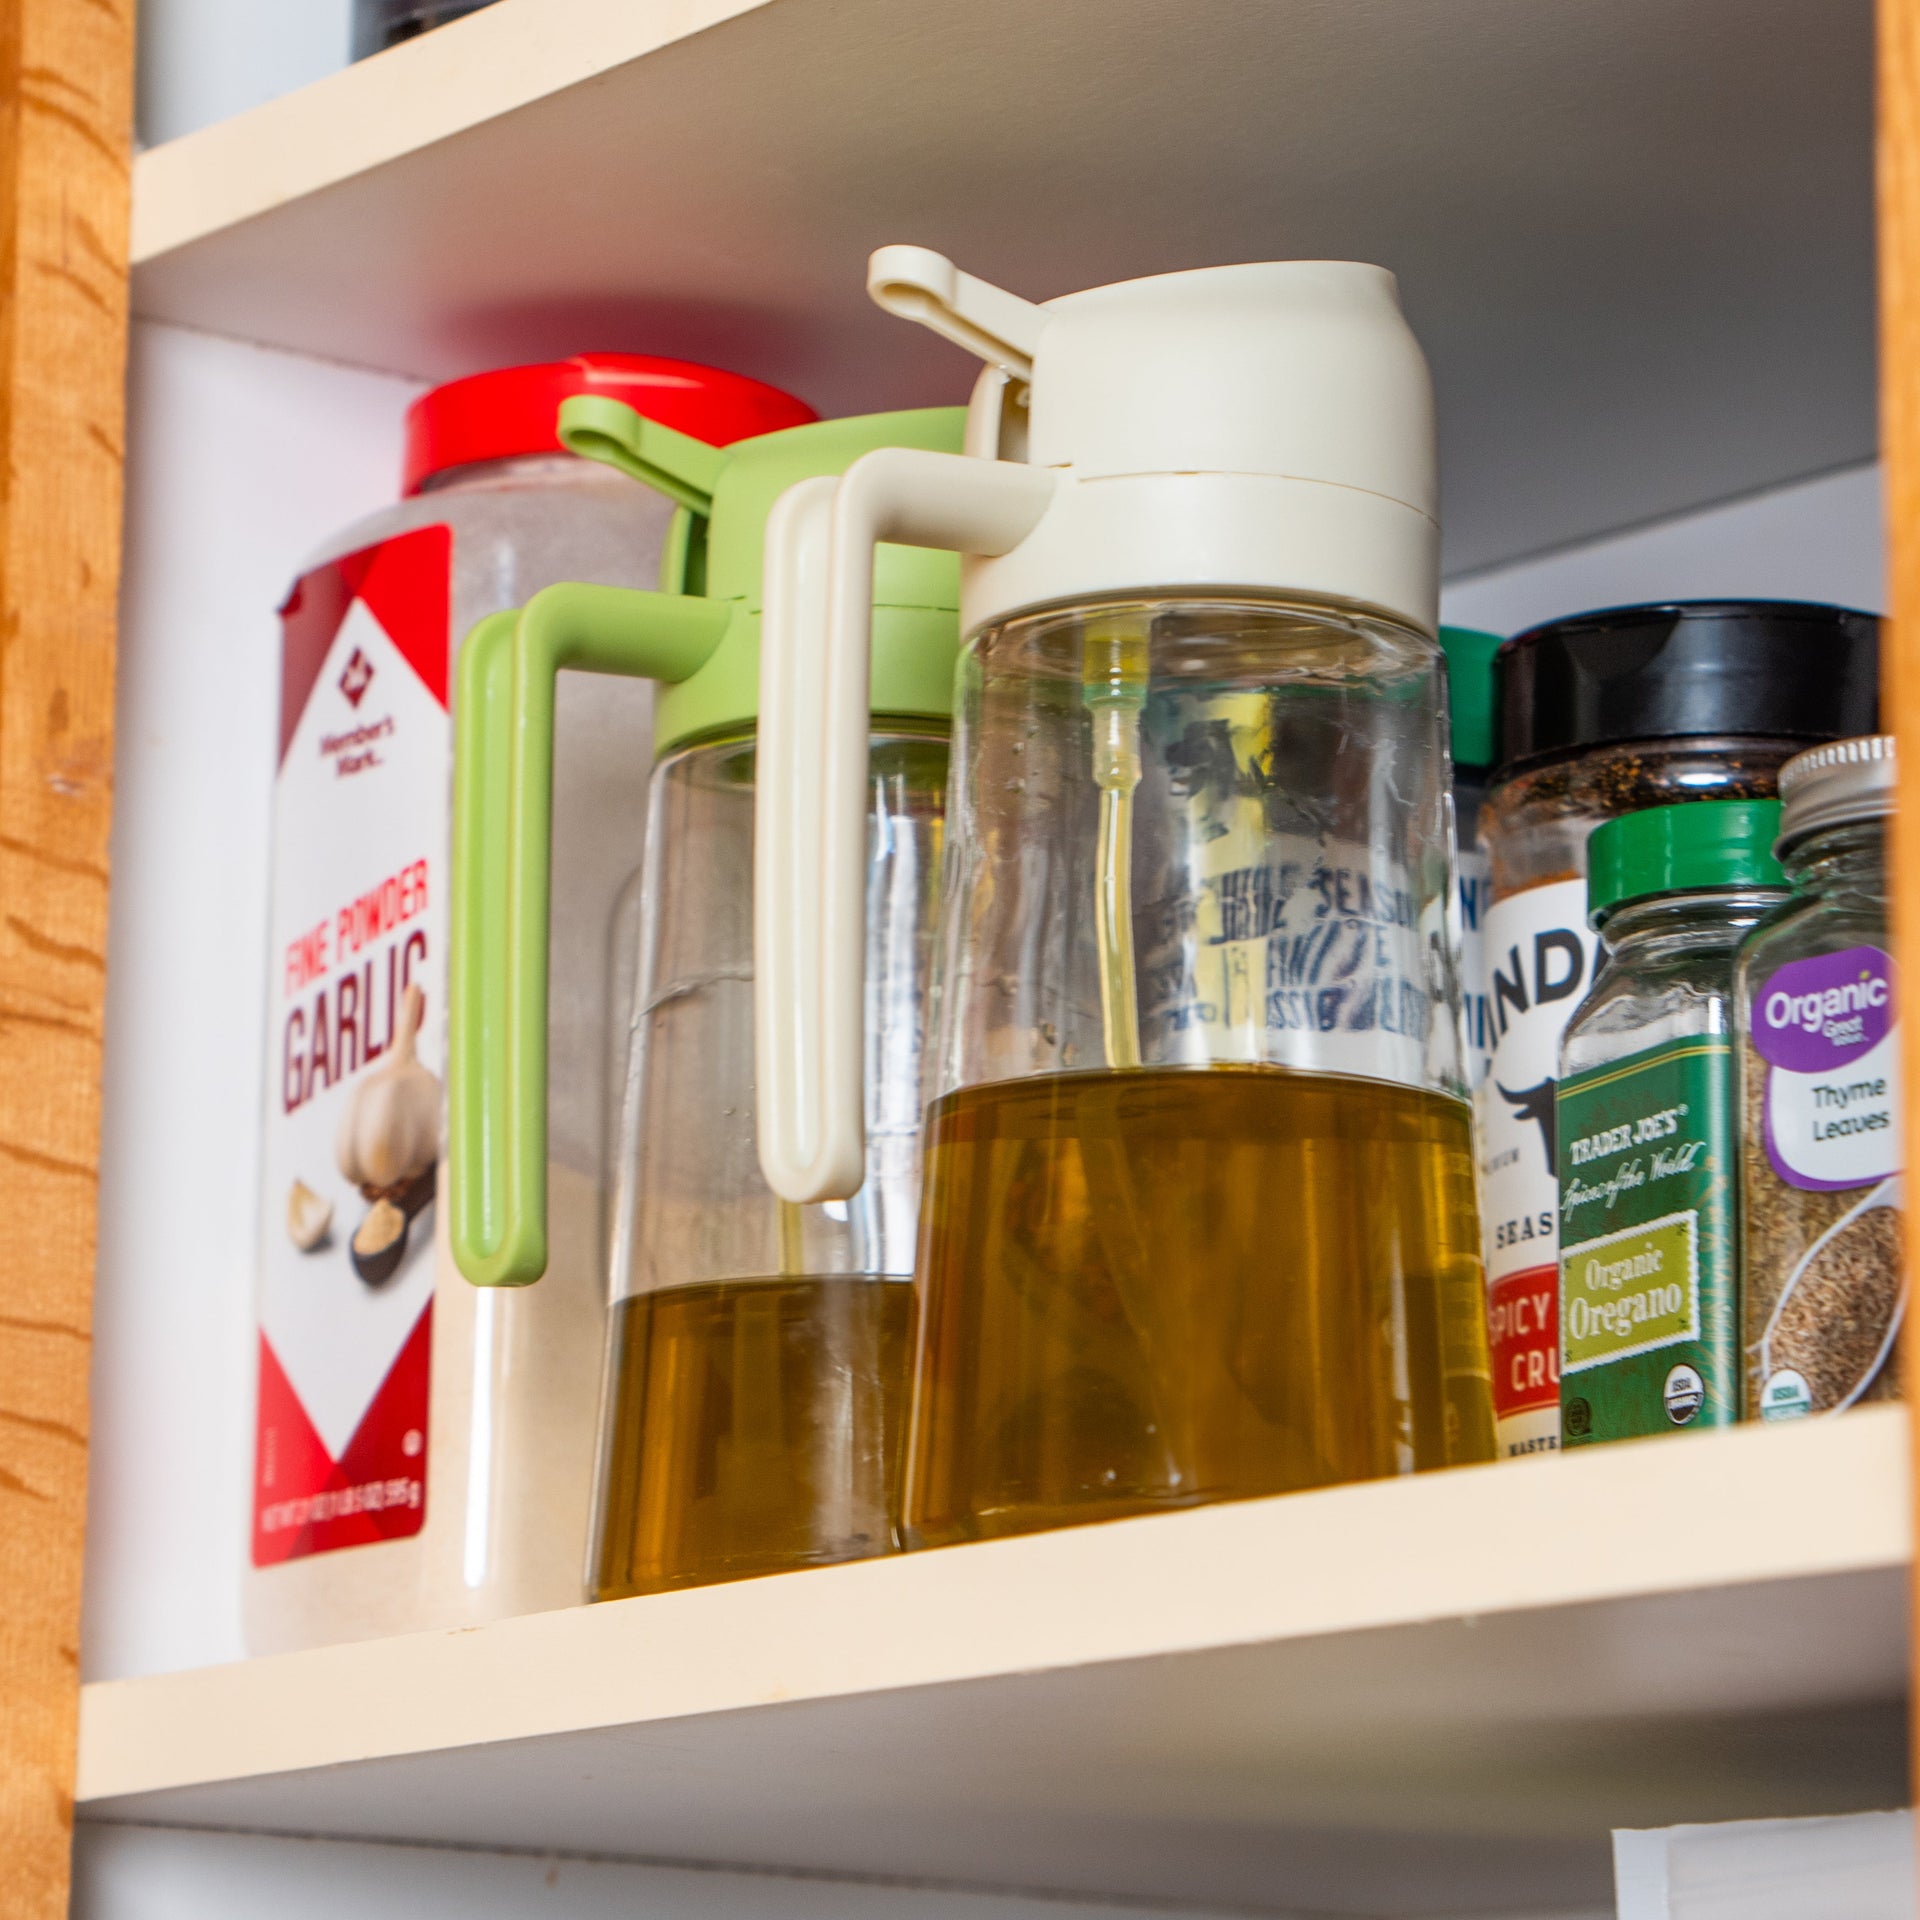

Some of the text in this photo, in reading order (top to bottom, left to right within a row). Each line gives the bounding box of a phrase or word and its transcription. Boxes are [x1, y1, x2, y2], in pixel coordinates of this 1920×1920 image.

[284, 856, 428, 999] FINE POWDER
[1765, 971, 1888, 1033] Organic
[1812, 1077, 1887, 1109] Thyme
[1569, 1123, 1632, 1166] TRADER
[1812, 1110, 1890, 1143] Leaves
[1585, 1241, 1664, 1291] Organic
[1568, 1283, 1683, 1341] Oregano
